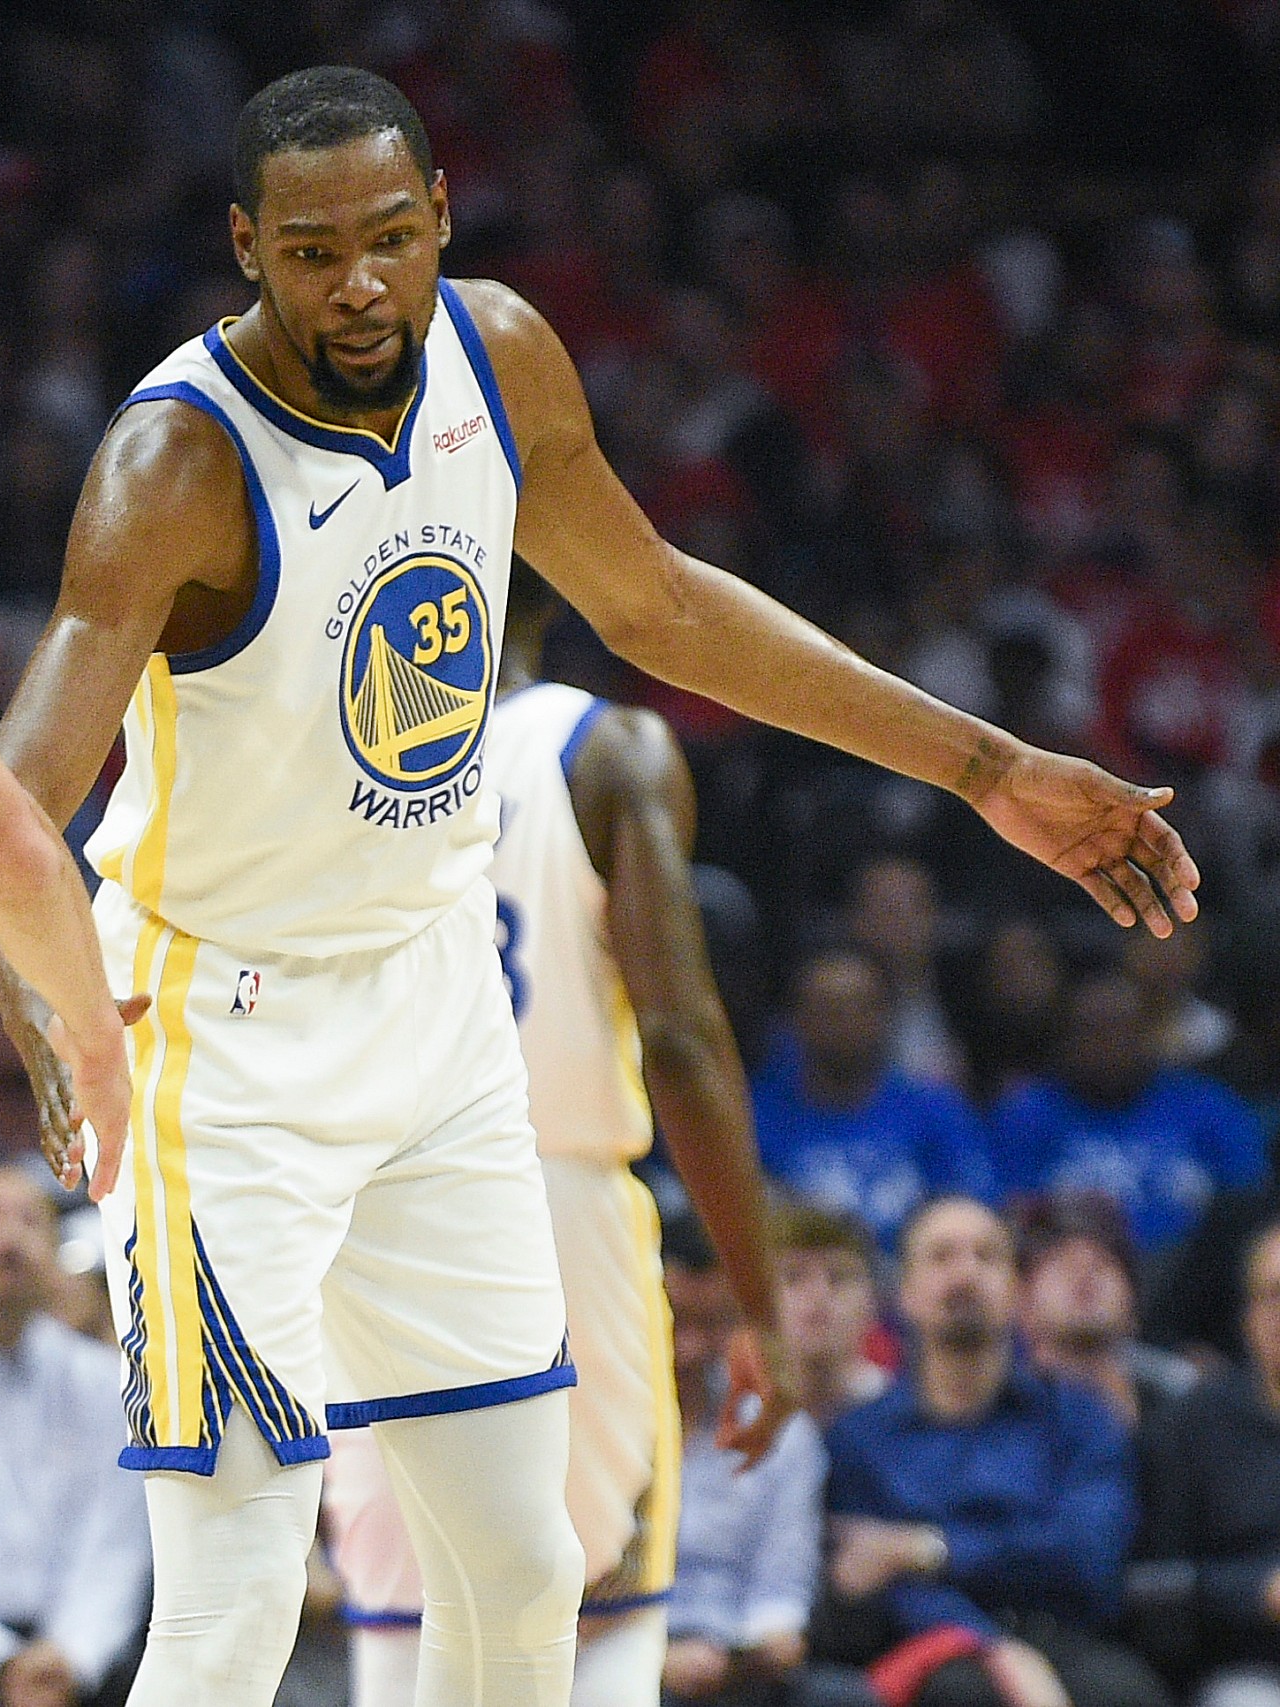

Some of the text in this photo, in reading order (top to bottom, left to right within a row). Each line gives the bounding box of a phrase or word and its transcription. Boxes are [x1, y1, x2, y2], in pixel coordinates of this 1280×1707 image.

[432, 415, 487, 453] Rakuten
[325, 525, 487, 640] GOLDEN STATE
[409, 584, 471, 666] 35
[348, 735, 487, 829] WARRIO
